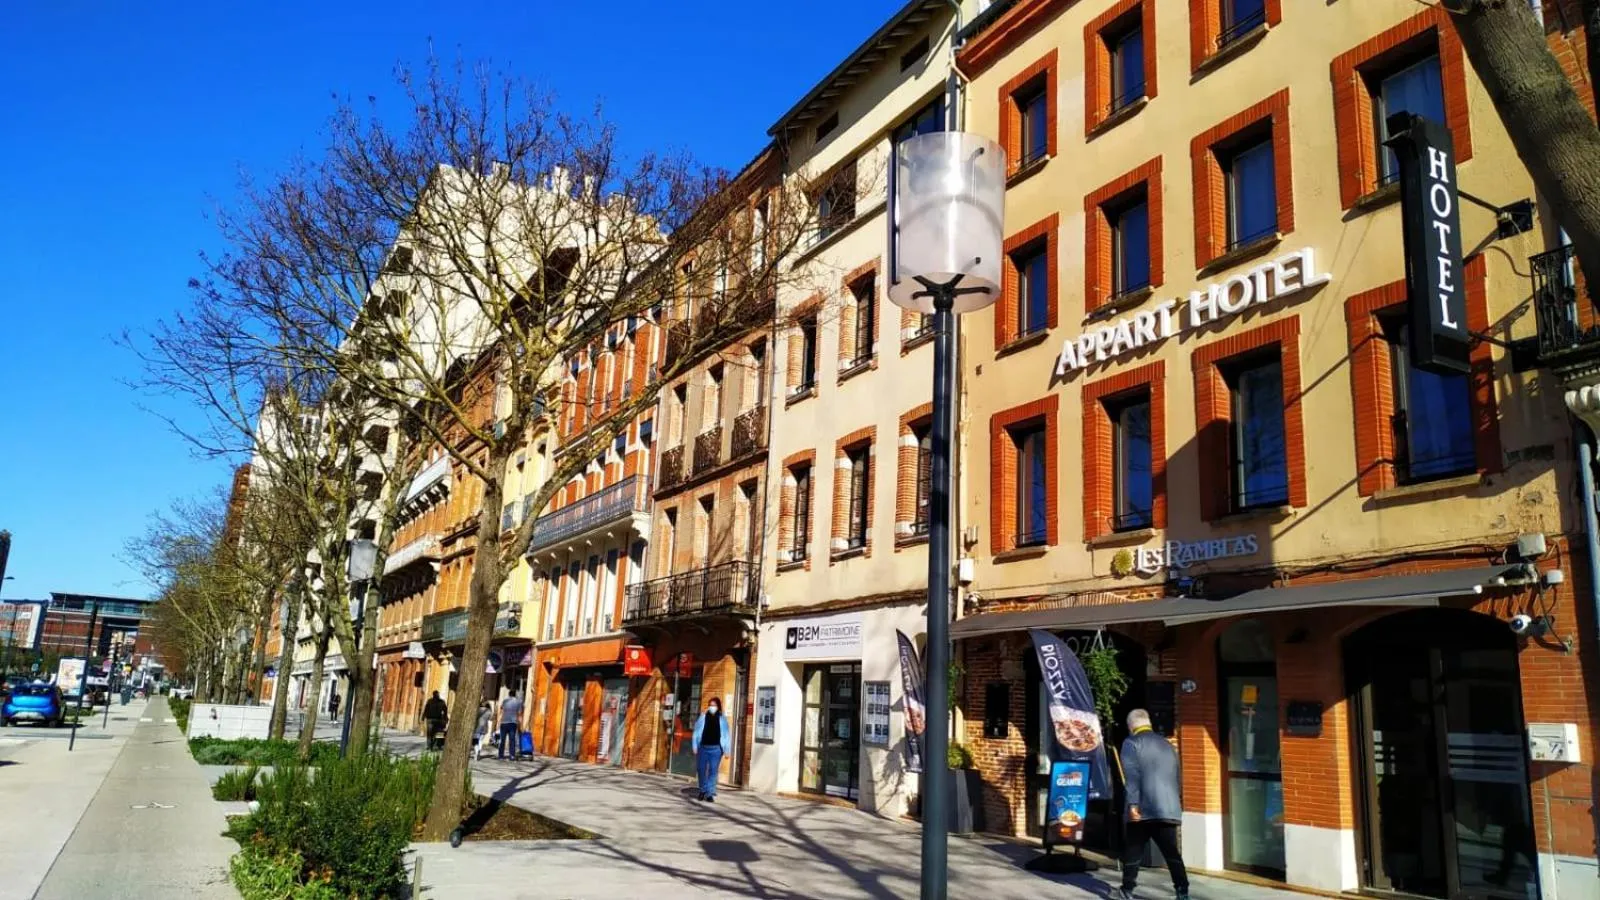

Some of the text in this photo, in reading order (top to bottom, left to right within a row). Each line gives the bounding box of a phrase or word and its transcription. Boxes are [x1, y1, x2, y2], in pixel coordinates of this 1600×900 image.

[1427, 146, 1458, 331] HOTEL
[1056, 247, 1332, 375] APPART HOTEL
[1166, 534, 1259, 568] RAMBLAS
[798, 625, 861, 641] B2M PATRIMOINE
